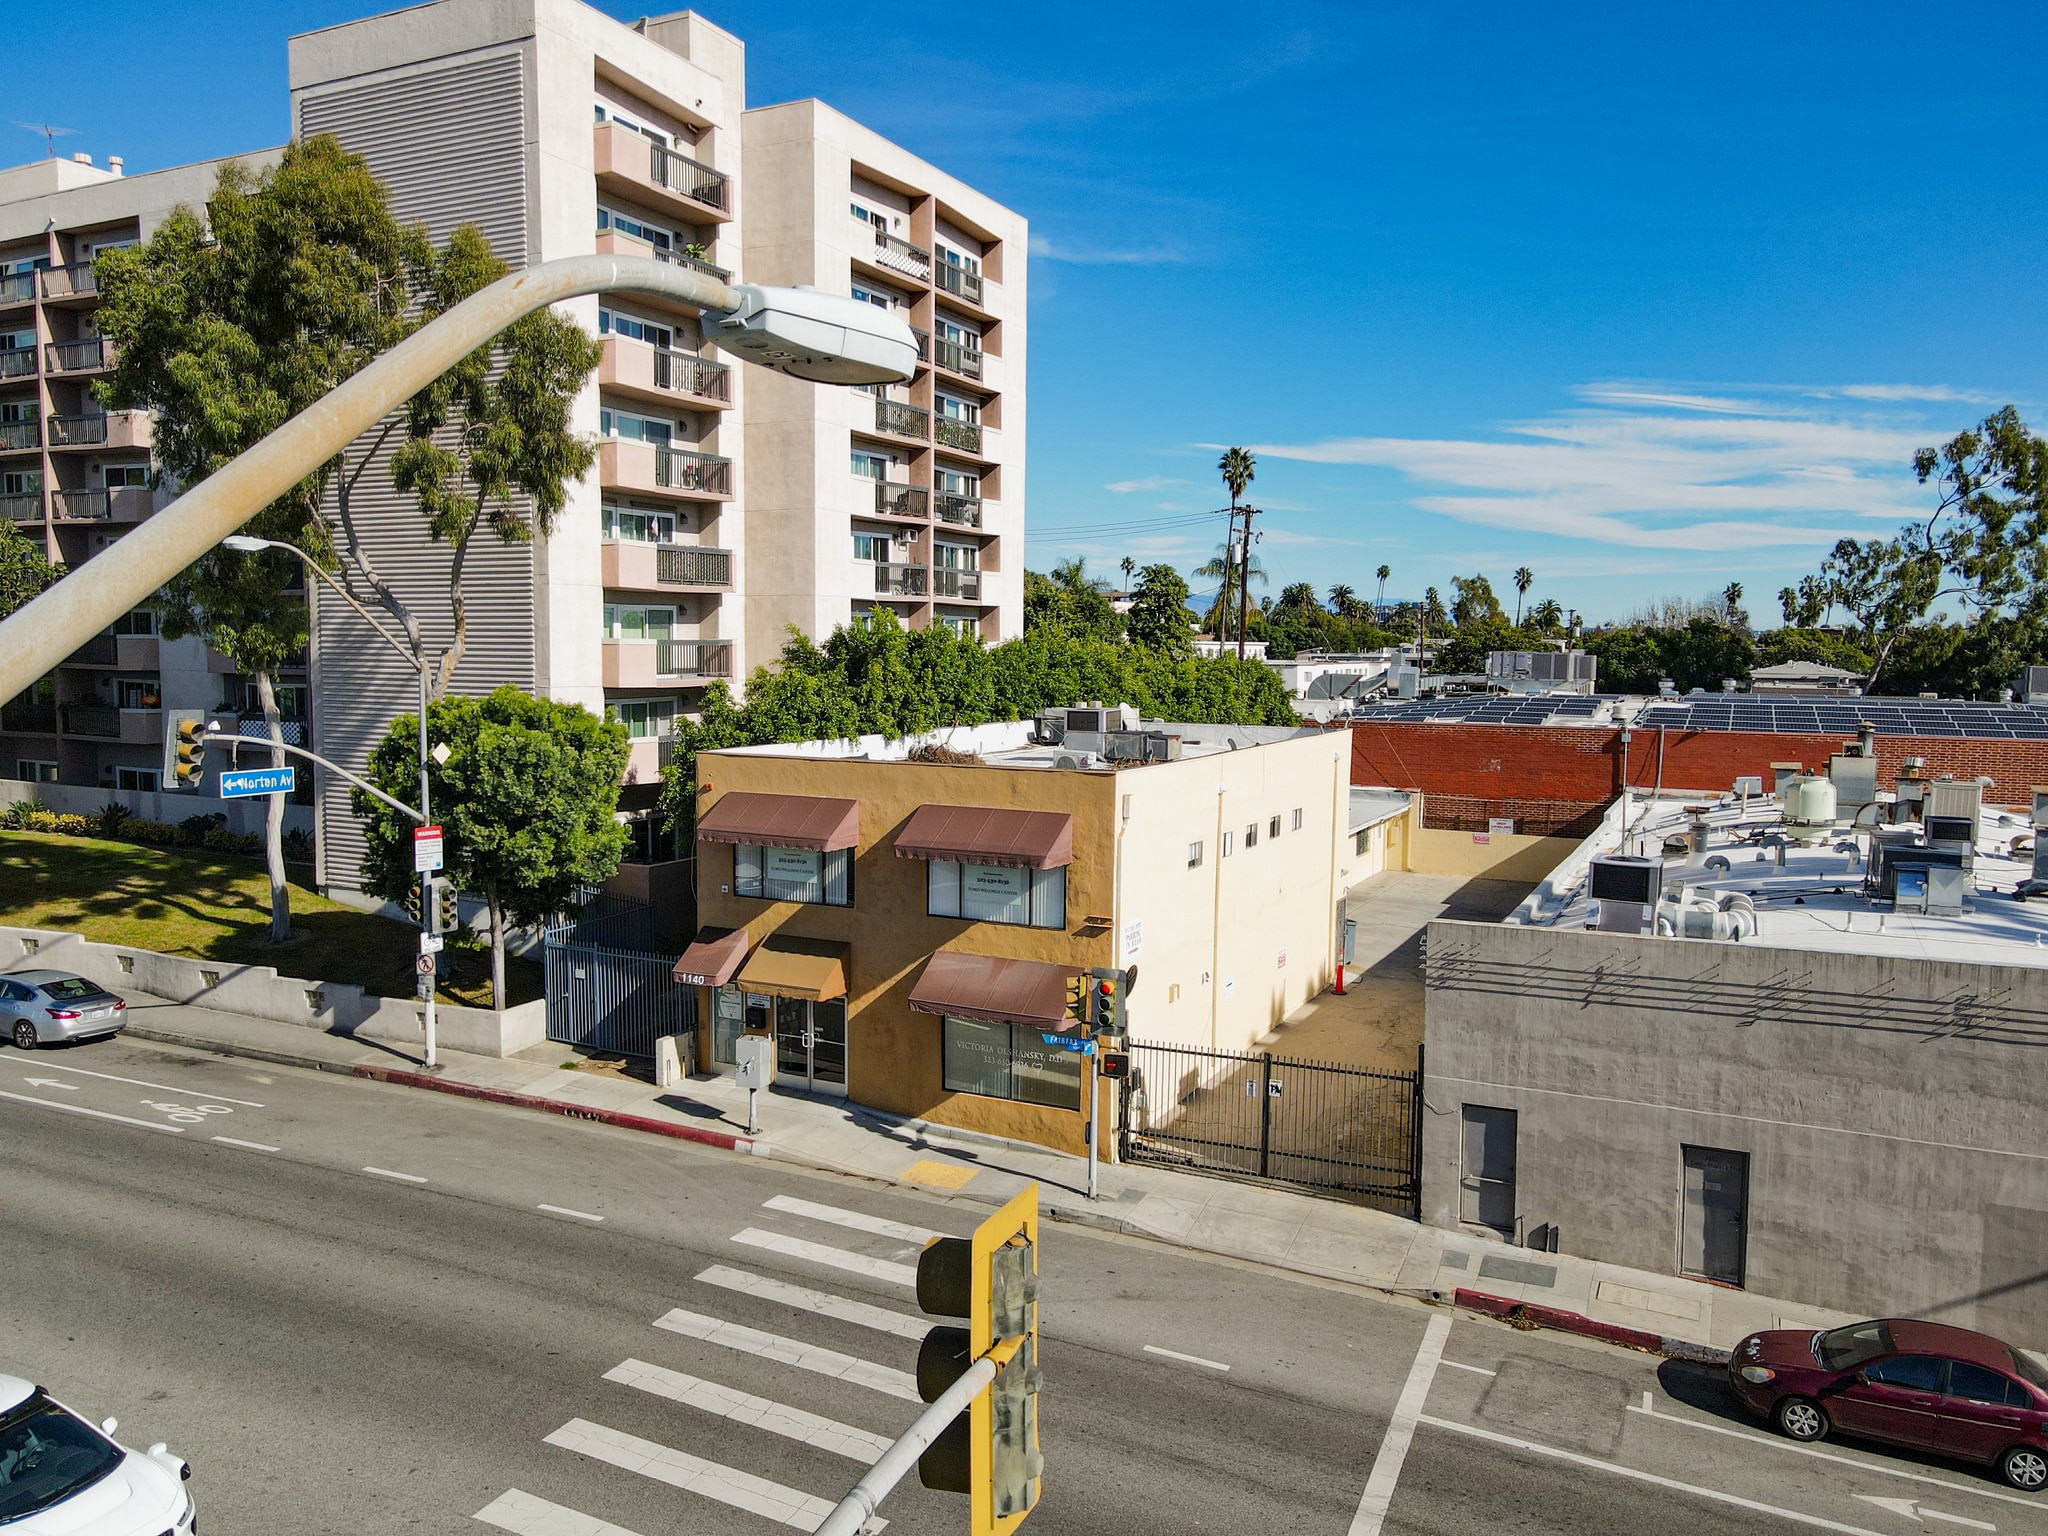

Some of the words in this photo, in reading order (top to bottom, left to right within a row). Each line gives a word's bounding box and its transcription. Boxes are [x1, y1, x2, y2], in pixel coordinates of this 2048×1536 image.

[239, 776, 277, 790] Norton
[280, 774, 292, 786] Av
[682, 973, 705, 985] 1140
[1050, 1035, 1079, 1046] FAIRFAX
[956, 1040, 994, 1053] VICTORIA
[997, 1046, 1046, 1062] OLSHANSKY,
